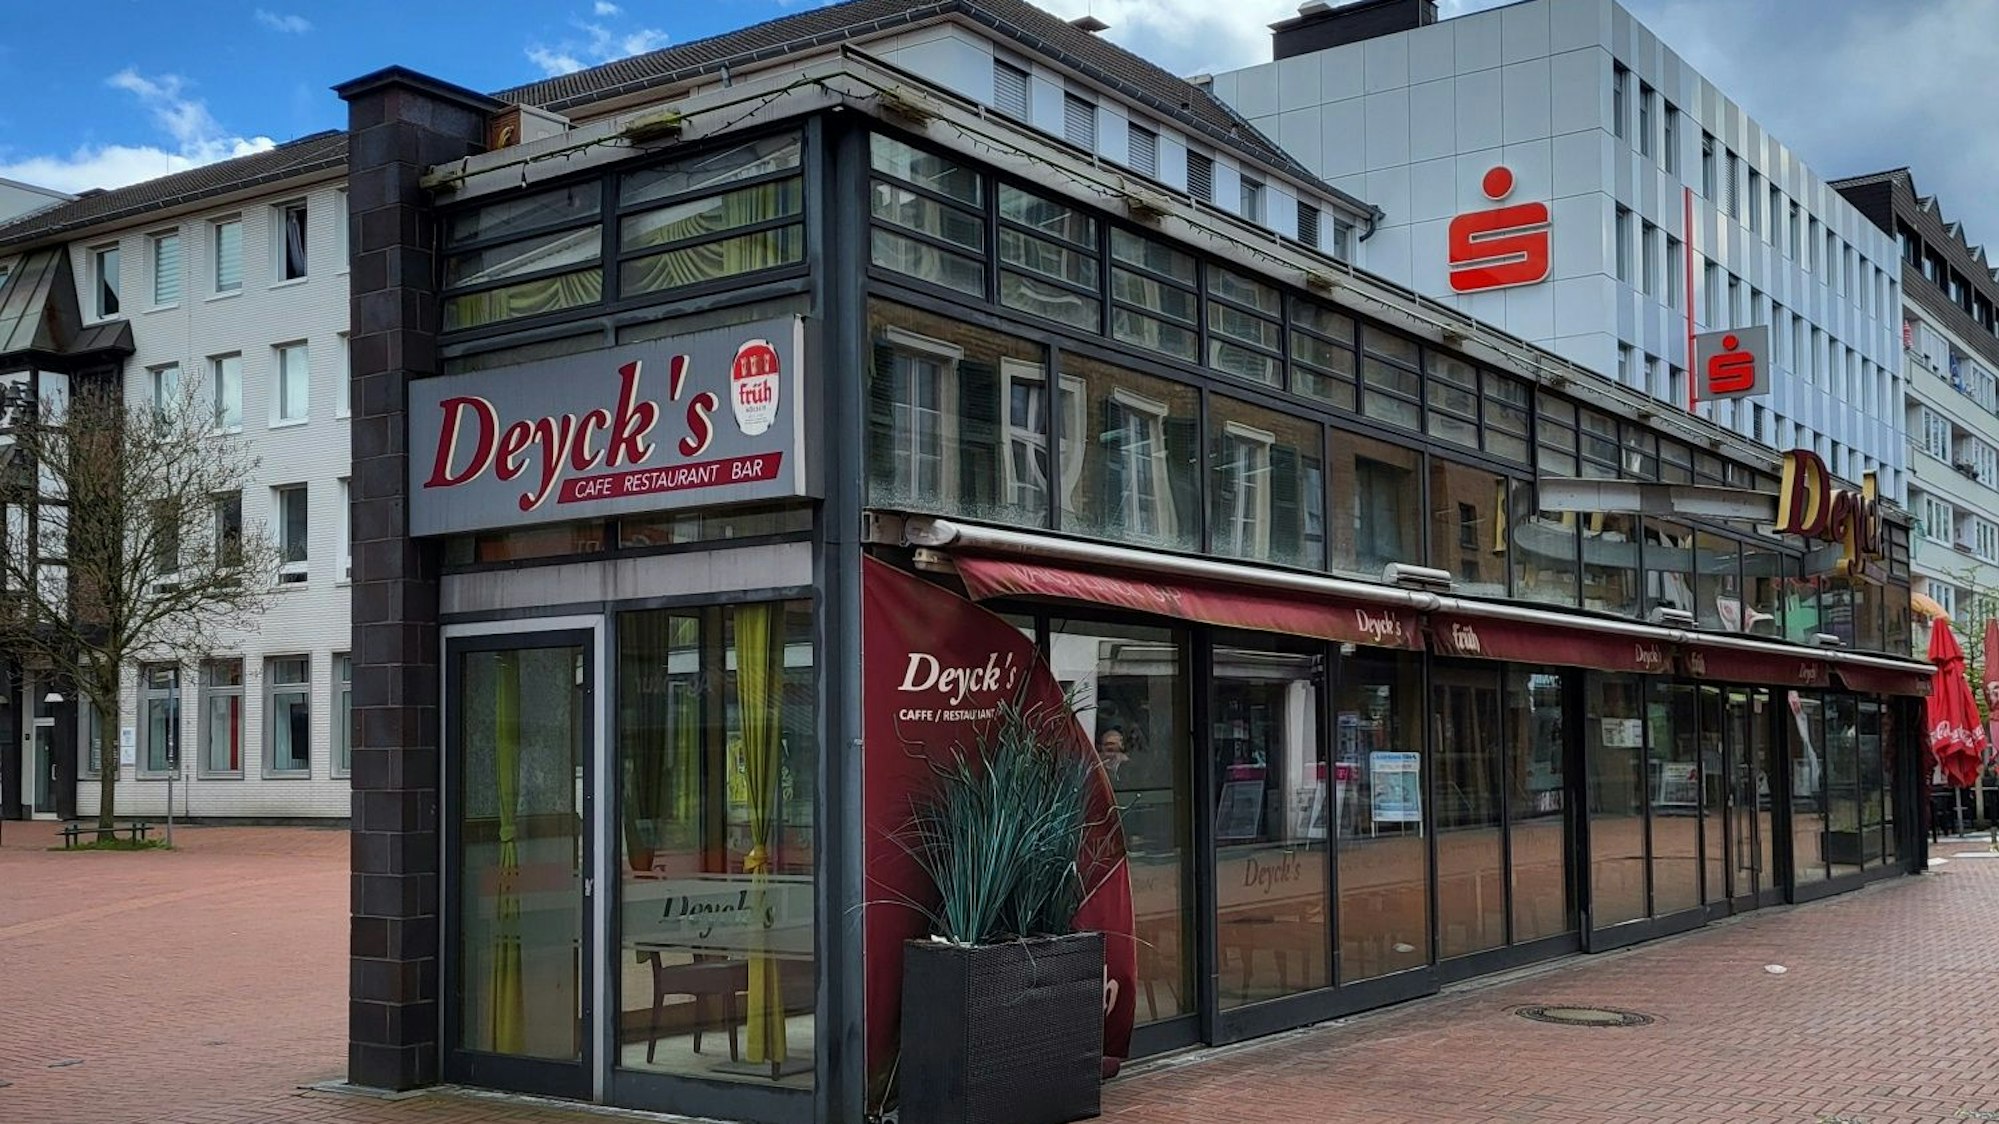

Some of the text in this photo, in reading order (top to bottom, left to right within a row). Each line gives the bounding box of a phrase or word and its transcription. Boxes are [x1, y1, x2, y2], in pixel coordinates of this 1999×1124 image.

[739, 379, 772, 405] früh
[423, 354, 720, 512] Deyck's
[575, 458, 763, 499] CAFE RESTAURANT BAR
[1355, 608, 1402, 642] Deyck's
[898, 652, 1017, 706] Deyck's
[899, 709, 933, 721] CAFFE
[1243, 853, 1302, 894] Deyck's
